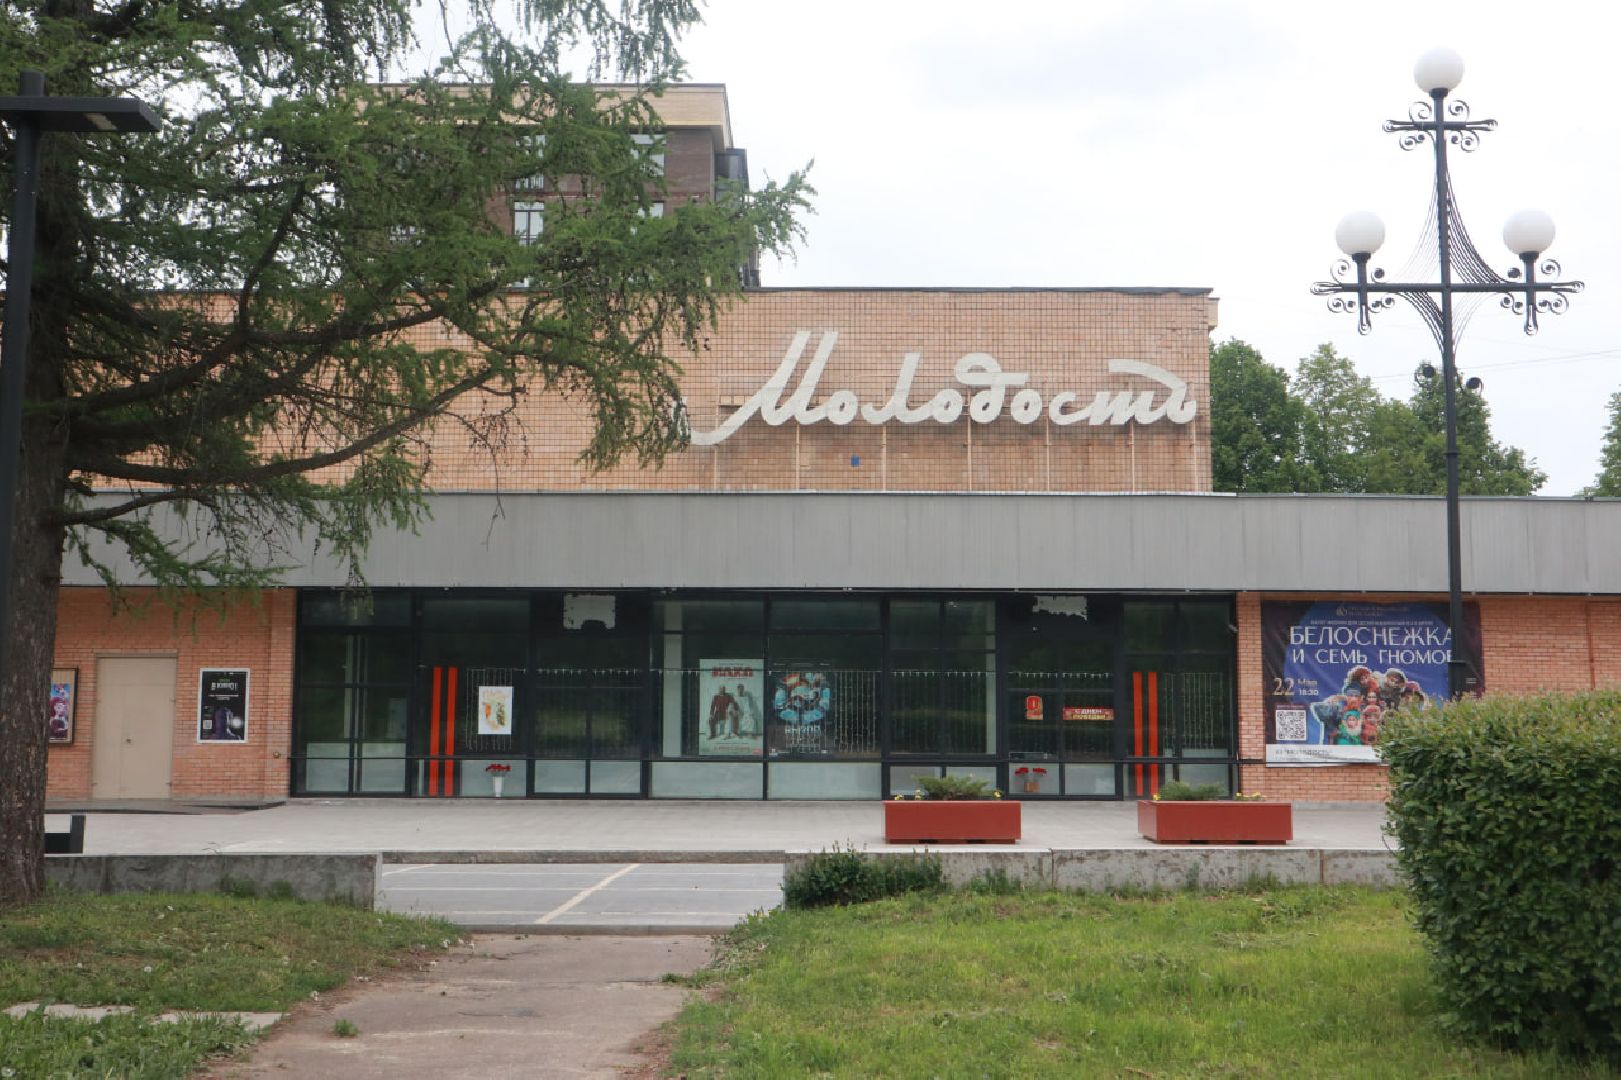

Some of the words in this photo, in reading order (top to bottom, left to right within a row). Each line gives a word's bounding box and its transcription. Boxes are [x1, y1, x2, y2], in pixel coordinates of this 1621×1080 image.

[673, 331, 1197, 446] Молодость
[1292, 649, 1305, 664] И
[1315, 649, 1368, 664] СЕМЬ
[1273, 677, 1295, 696] 22
